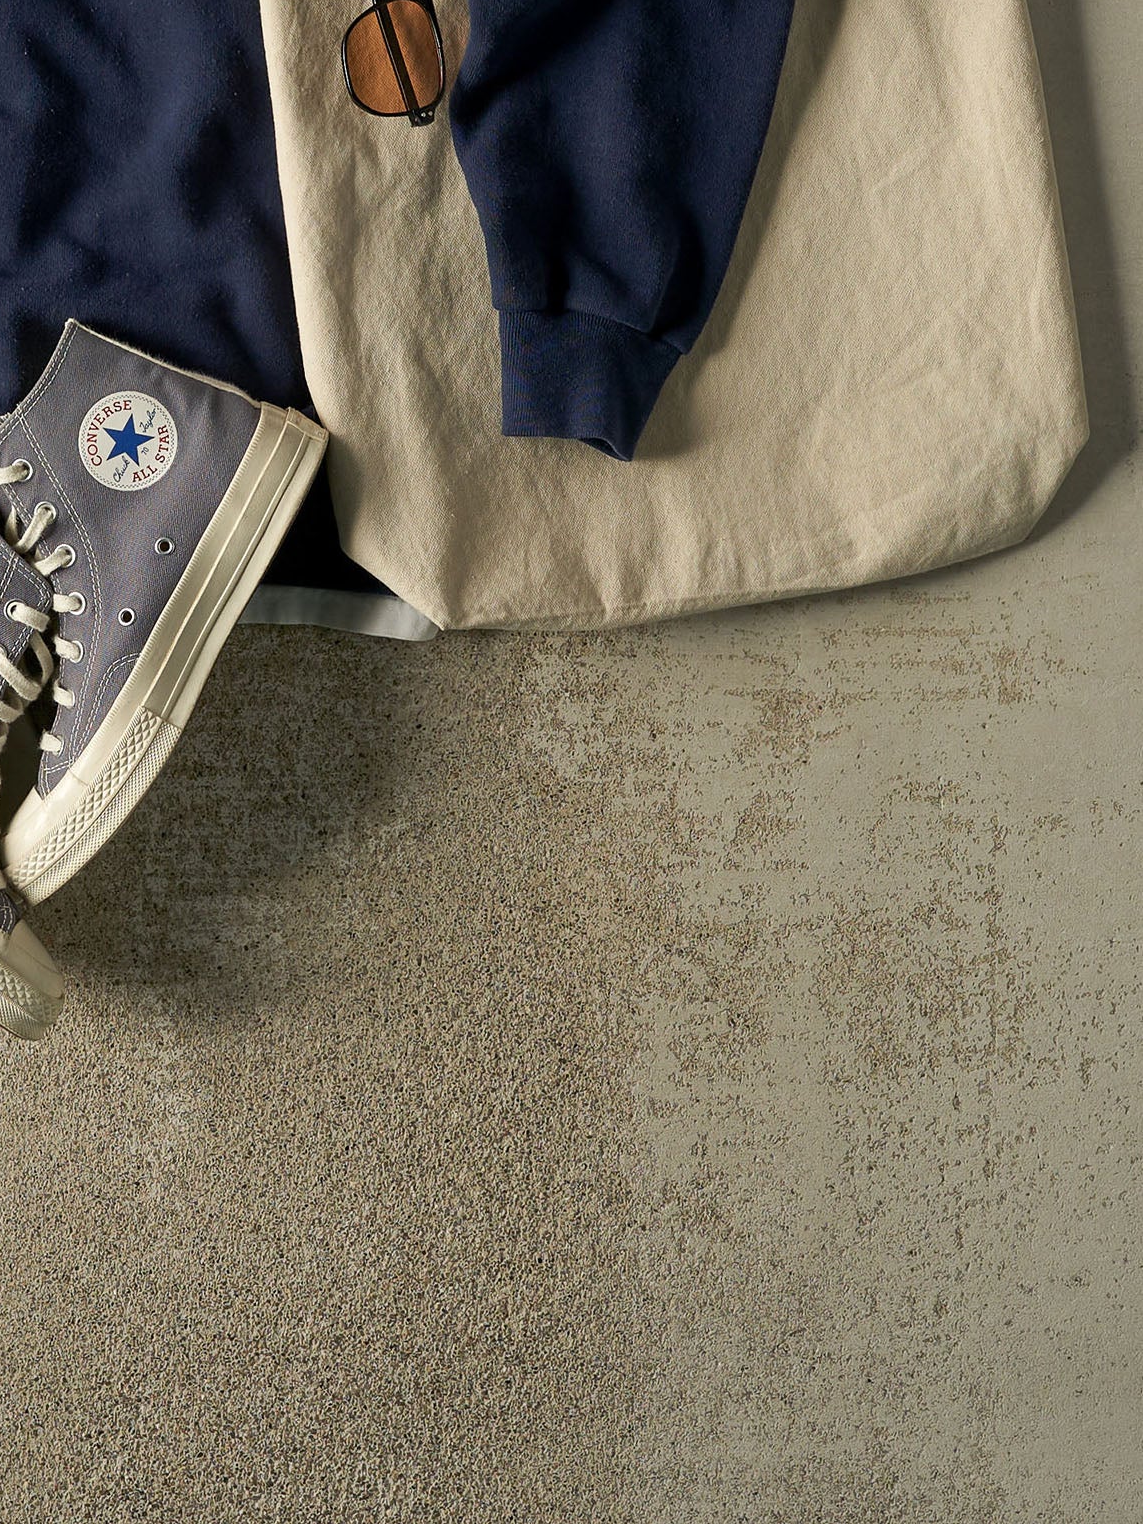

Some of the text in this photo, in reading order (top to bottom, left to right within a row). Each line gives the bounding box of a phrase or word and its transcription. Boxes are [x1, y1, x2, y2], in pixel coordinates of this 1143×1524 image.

[87, 400, 132, 466] CONVERSE
[113, 408, 157, 483] Chuck Taylor
[132, 424, 170, 483] ALL STAR
